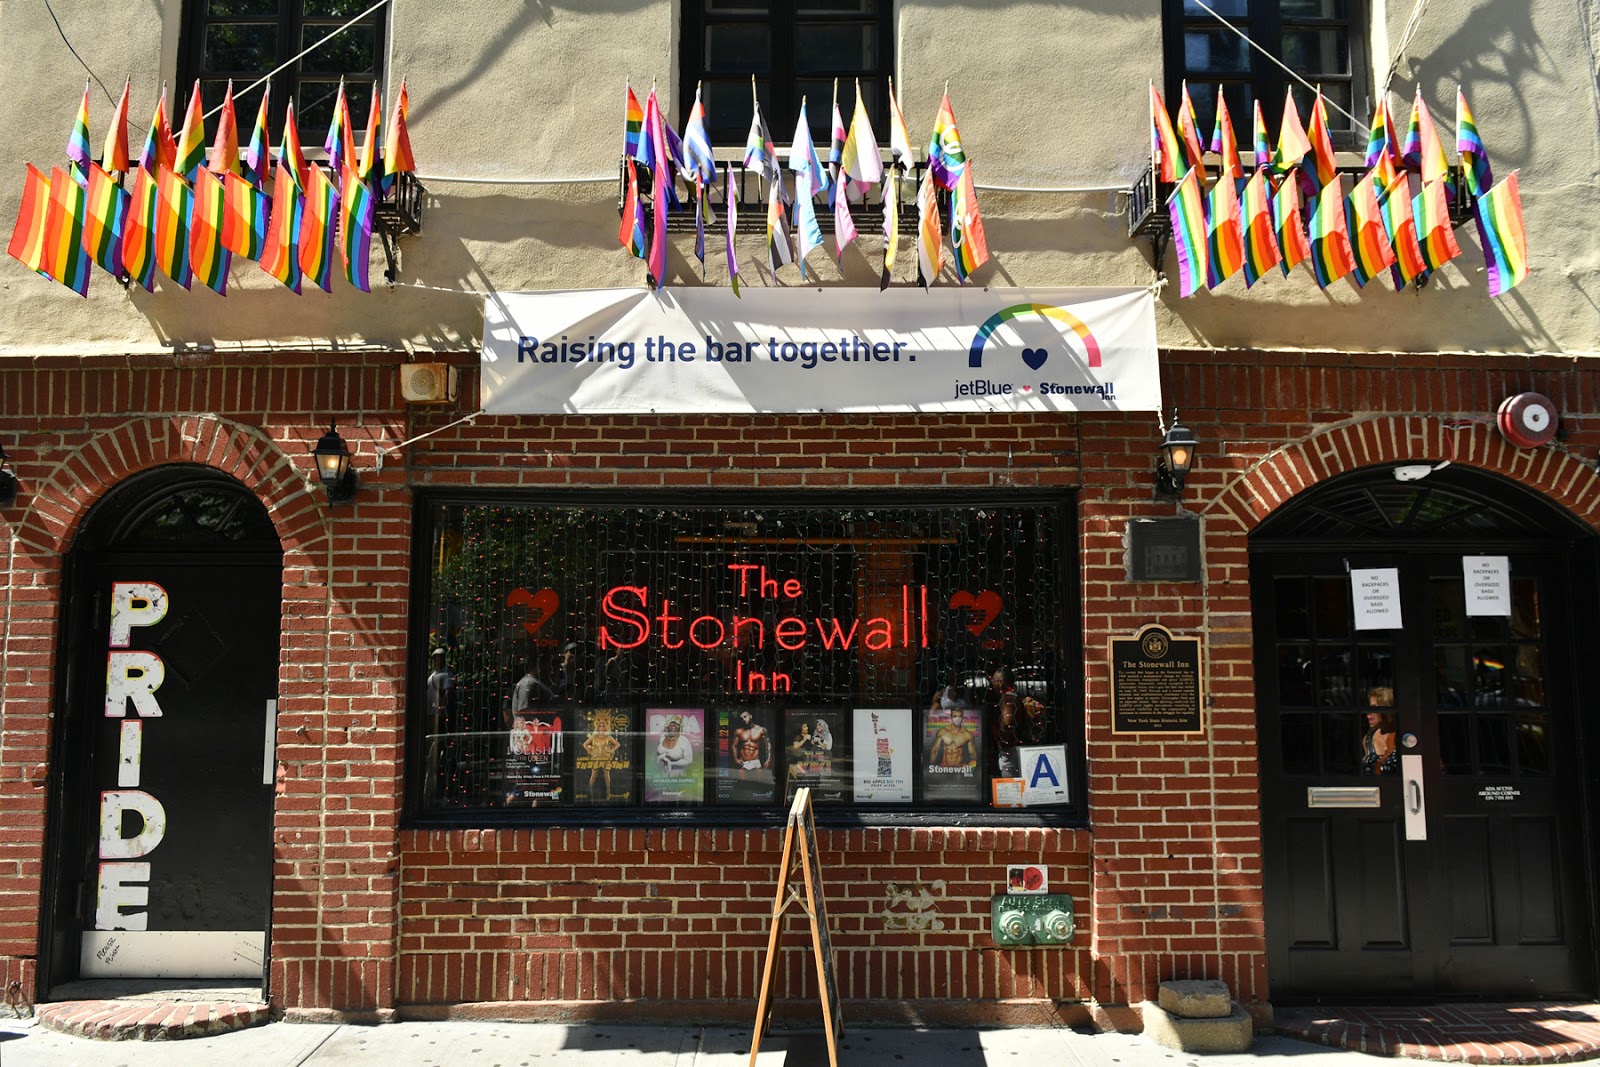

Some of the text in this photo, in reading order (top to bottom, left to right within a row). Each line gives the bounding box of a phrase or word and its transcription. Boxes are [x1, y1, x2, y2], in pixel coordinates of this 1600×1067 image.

[518, 335, 916, 370] Raising the bar together.
[954, 380, 1012, 398] jetBlue
[1040, 382, 1114, 395] Stonewall
[727, 563, 803, 598] The
[600, 584, 928, 651] Stonewall
[736, 659, 791, 694] Inn
[95, 581, 169, 931] PRIDE
[928, 764, 973, 773] Stonewall
[1030, 754, 1060, 788] A
[1001, 896, 1029, 905] AUTO
